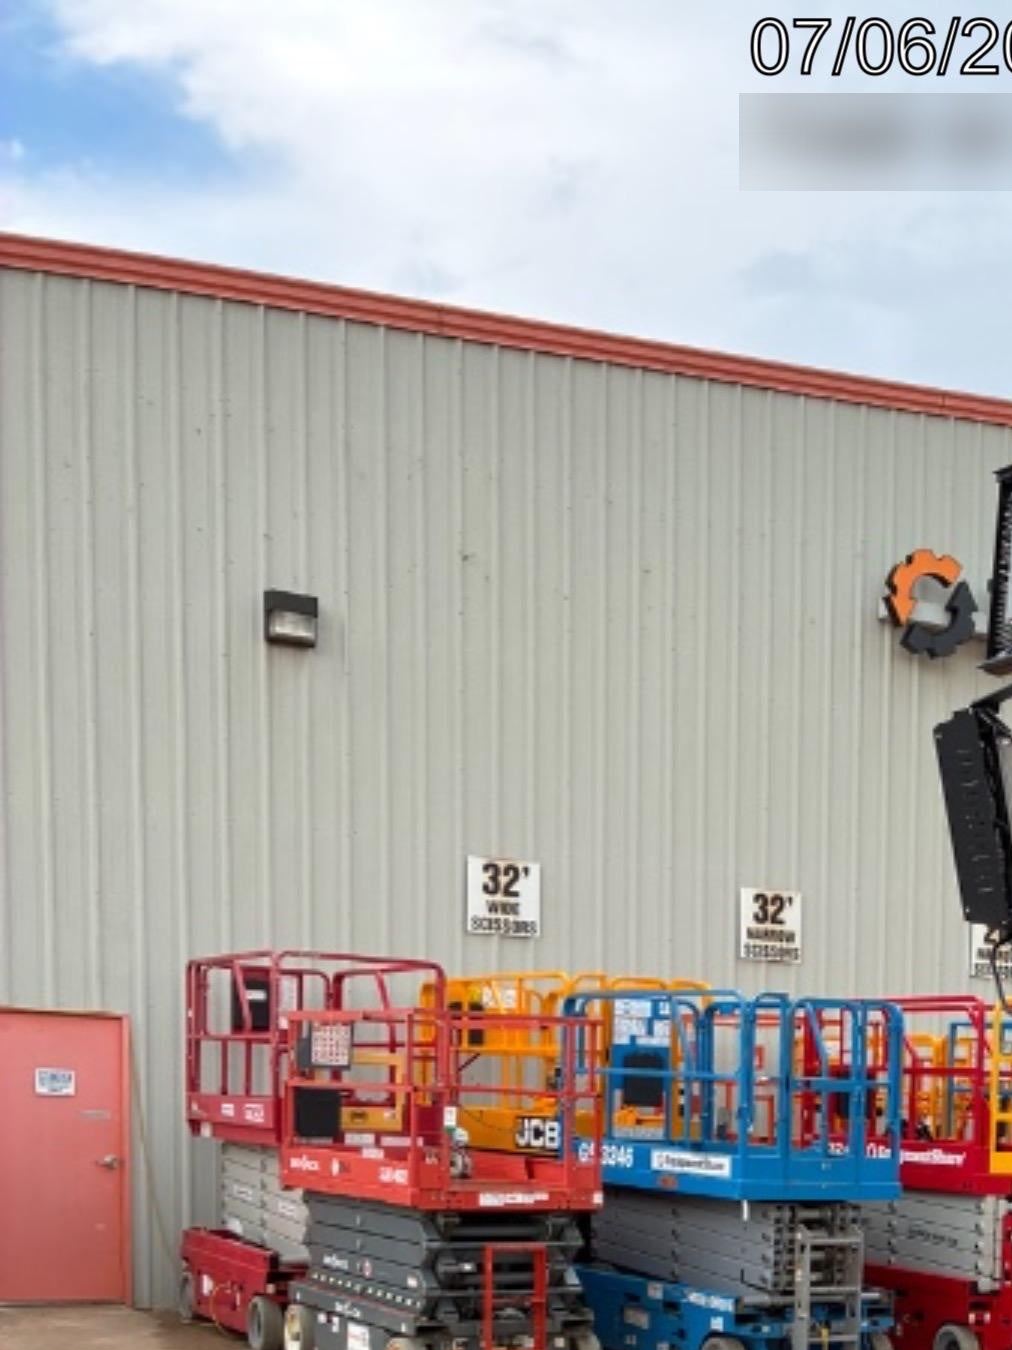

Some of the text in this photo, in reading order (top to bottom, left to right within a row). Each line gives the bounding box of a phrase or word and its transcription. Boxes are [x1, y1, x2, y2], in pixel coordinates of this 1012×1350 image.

[482, 863, 530, 897] 32'
[753, 893, 793, 925] 32'
[516, 1117, 561, 1149] JCB
